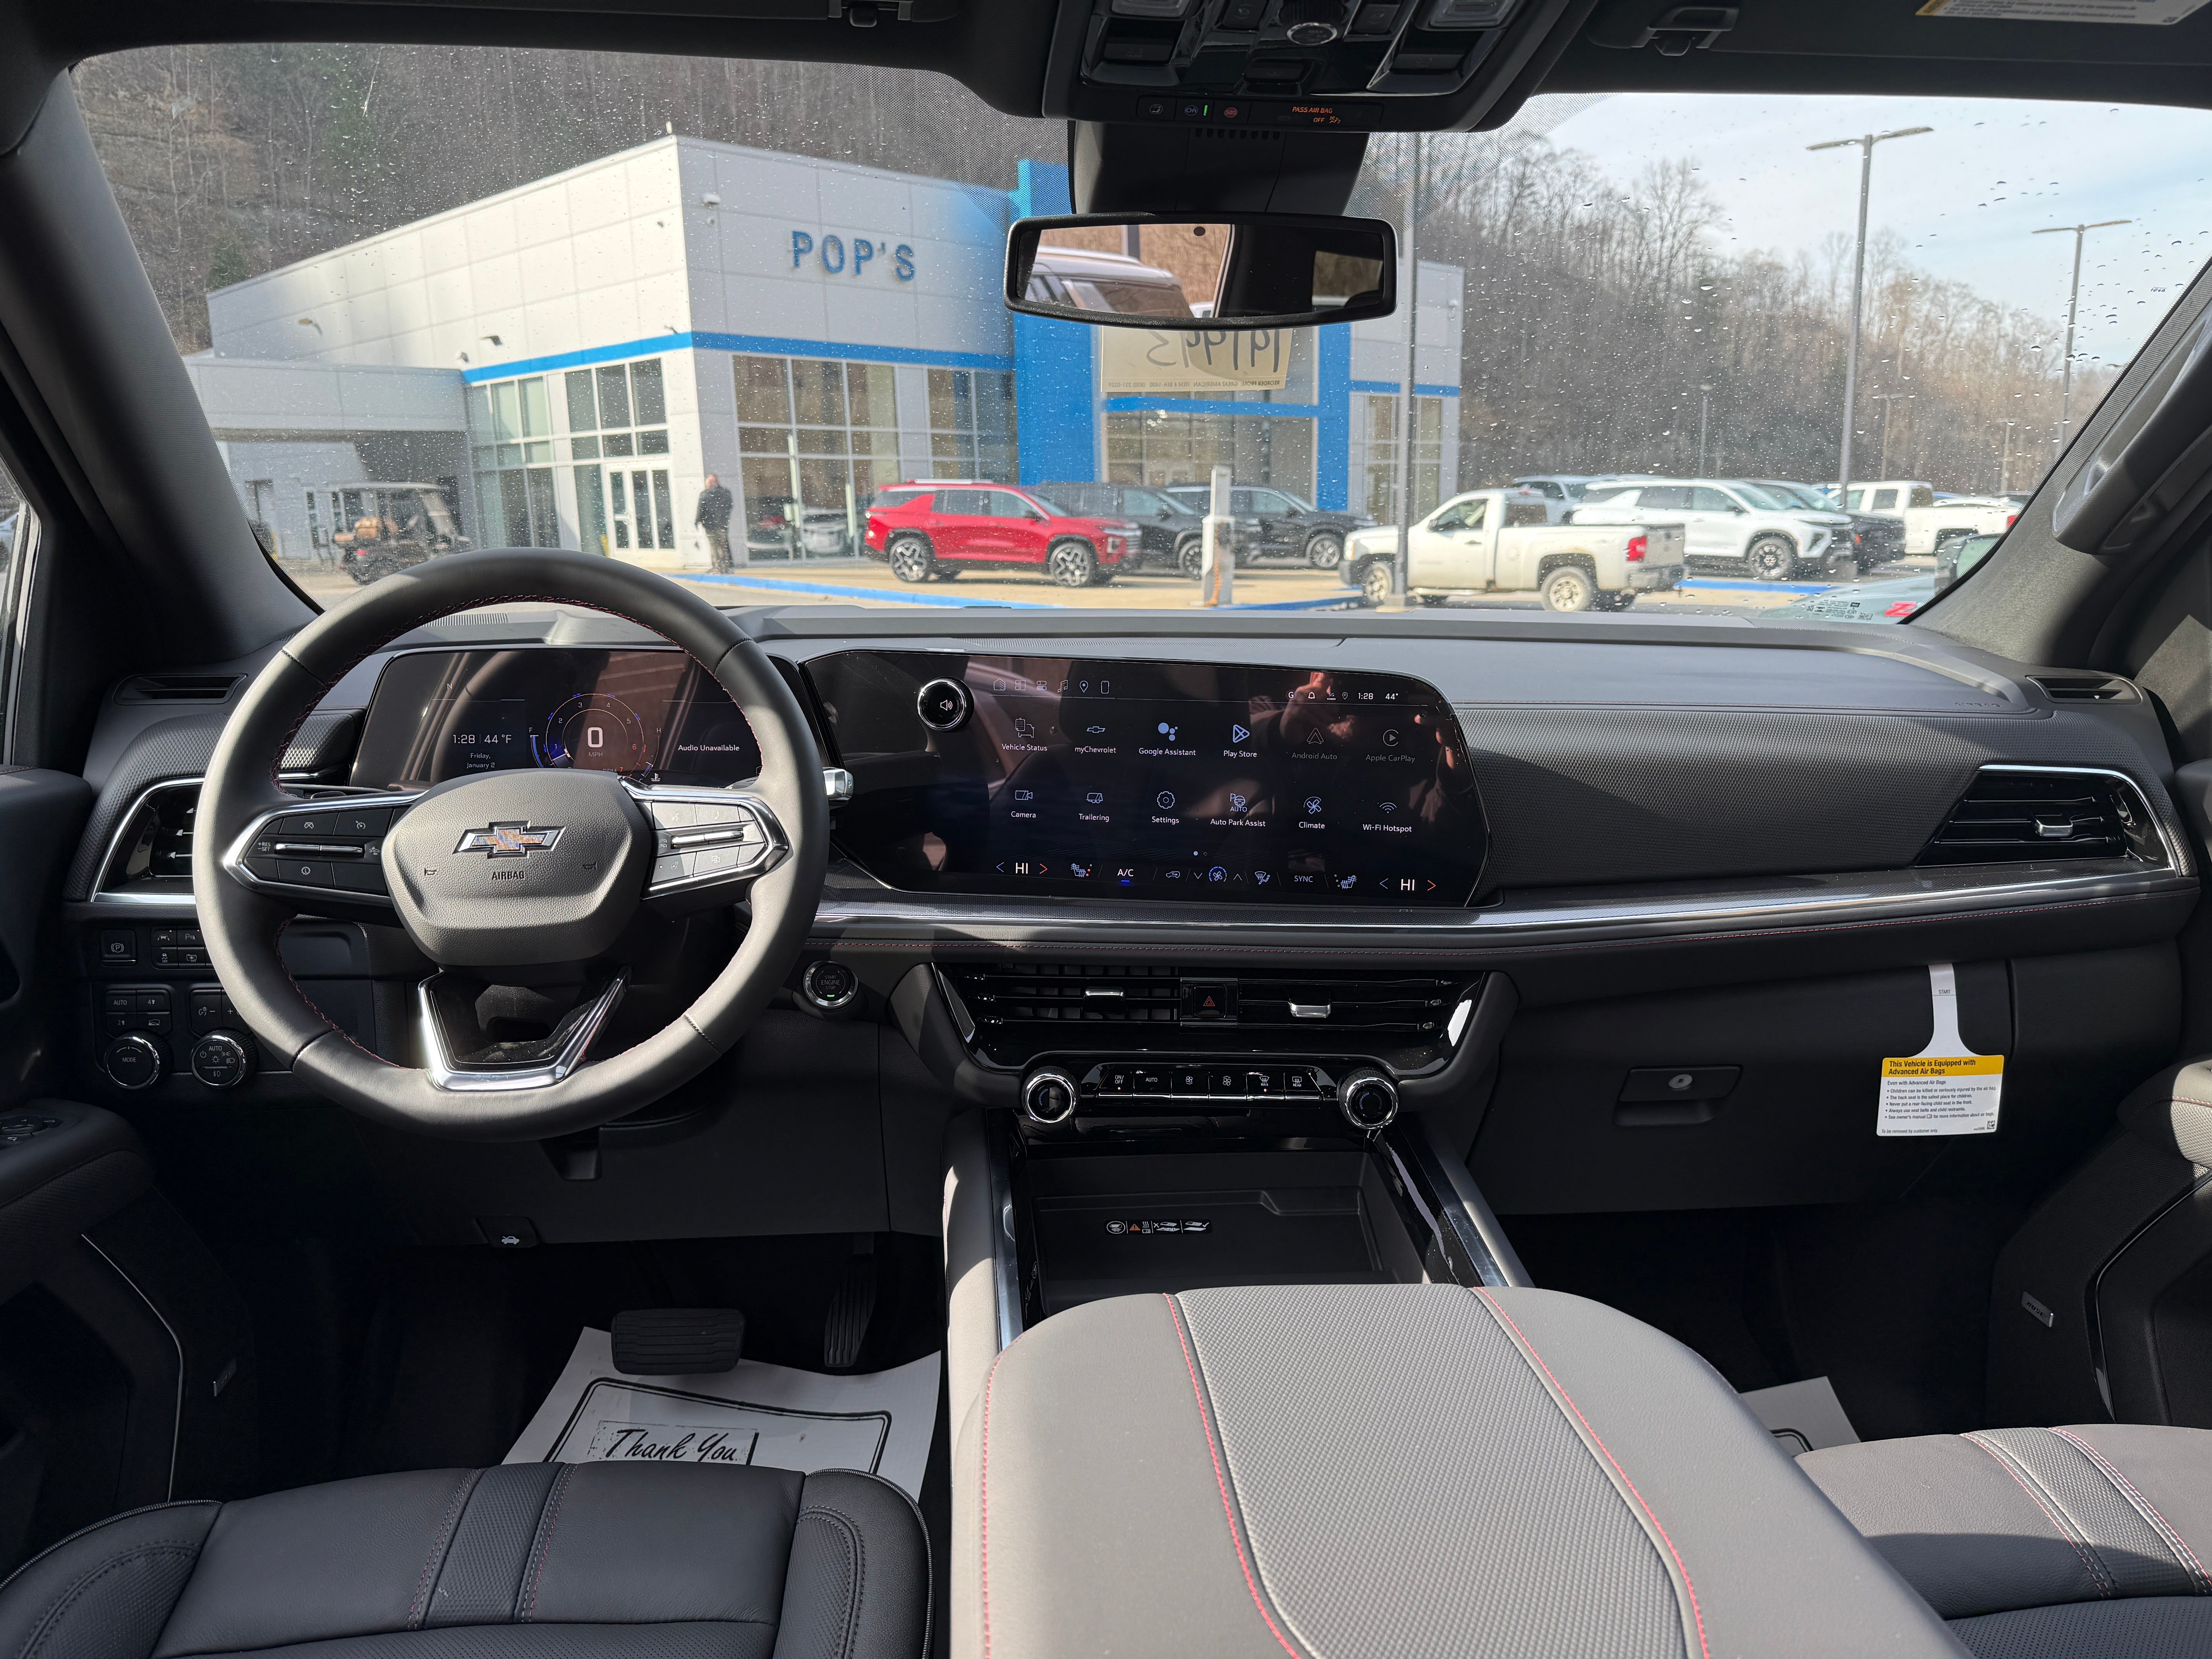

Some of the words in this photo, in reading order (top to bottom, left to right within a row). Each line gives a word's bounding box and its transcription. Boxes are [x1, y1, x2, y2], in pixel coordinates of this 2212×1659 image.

[792, 230, 915, 282] POP'S
[453, 735, 475, 744] 1:28
[484, 735, 498, 744] 44
[501, 734, 512, 744] °F
[587, 727, 603, 748] 0
[1075, 746, 1116, 754] myChevrolet
[1139, 748, 1163, 756] Google
[1223, 750, 1237, 758] Play
[1388, 755, 1415, 764] CarPlay
[1079, 814, 1109, 823] Trailering
[1151, 816, 1179, 824] Settings
[1383, 824, 1412, 833] Hotspot
[1015, 862, 1028, 874] HI
[492, 871, 525, 880] AIRBAG
[1117, 869, 1134, 877] A/C
[1401, 879, 1415, 891] HI
[1934, 1060, 1961, 1068] Equipped
[605, 1429, 696, 1460] Thank
